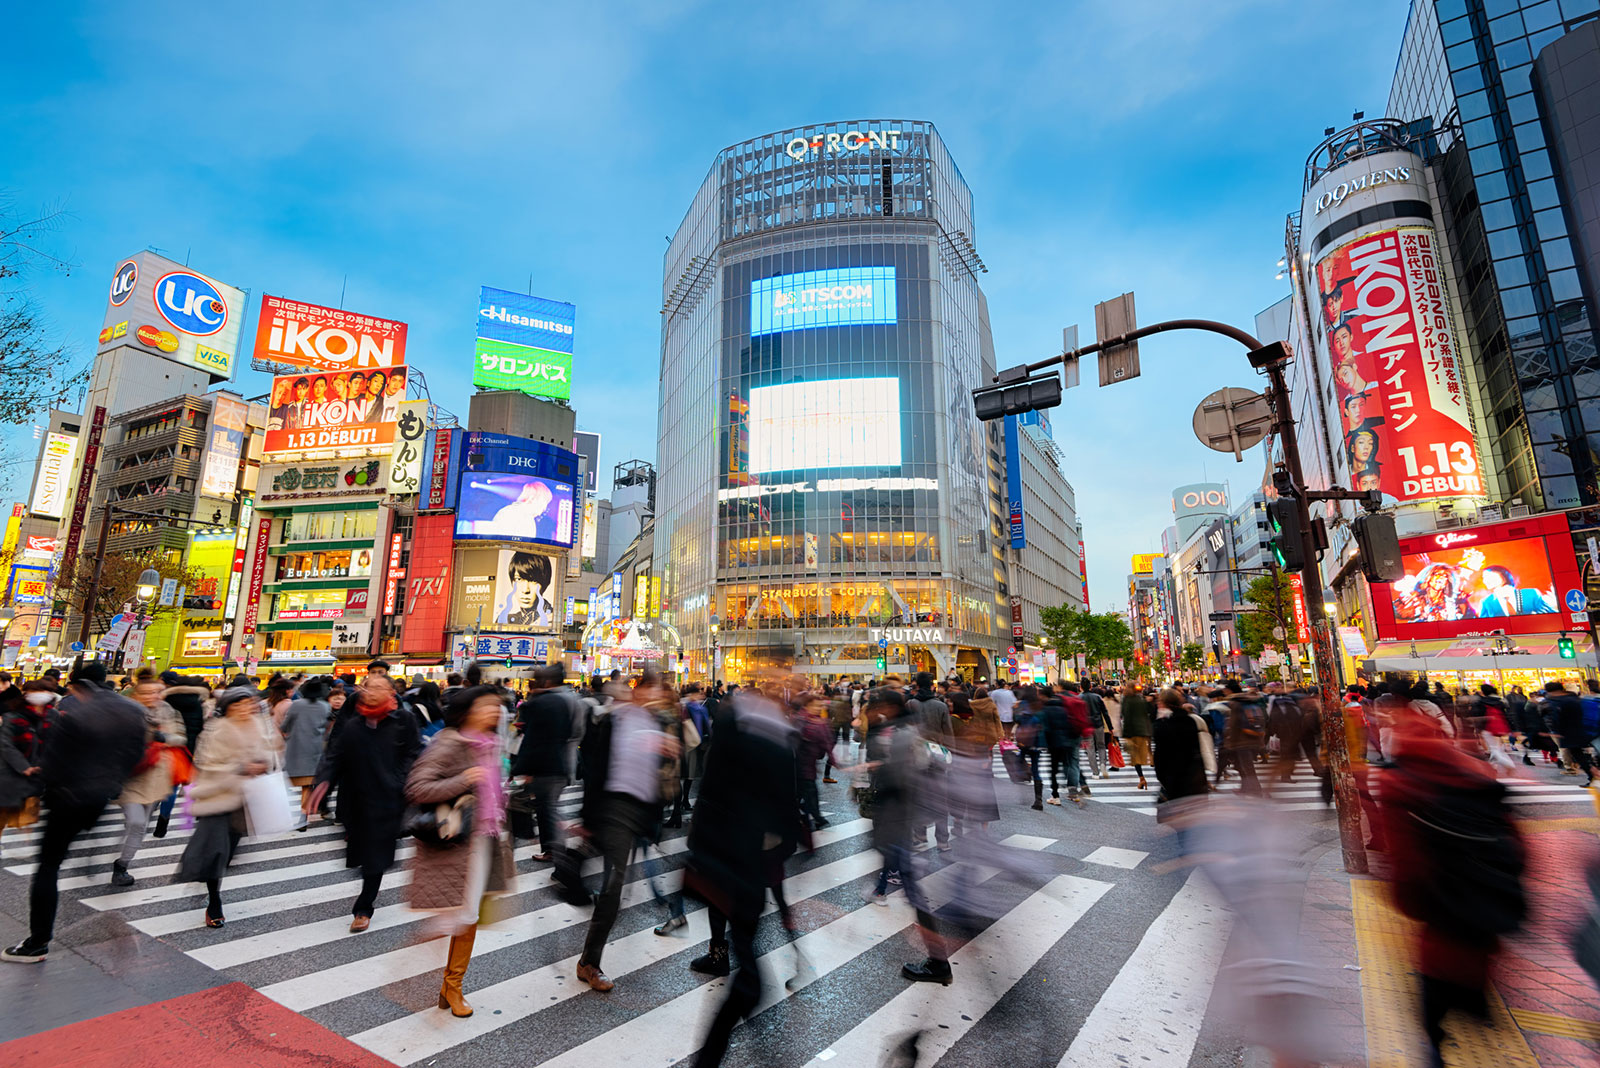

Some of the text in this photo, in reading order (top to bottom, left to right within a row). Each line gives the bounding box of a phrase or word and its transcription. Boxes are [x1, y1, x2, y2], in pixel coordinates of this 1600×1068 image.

[787, 130, 902, 163] QFRONT
[164, 280, 222, 326] UC
[801, 284, 873, 304] ITSCOM
[1348, 237, 1415, 353] iKON
[480, 305, 573, 335] Hisamitsu
[268, 317, 395, 367] iKON
[199, 350, 229, 368] VISA
[312, 358, 350, 371] アイコン
[480, 353, 567, 383] サロンパス
[1379, 349, 1419, 433] アイコン
[302, 399, 368, 426] iKON
[287, 428, 377, 449] 1.13 DEBUT!
[391, 409, 425, 490] もんじゃ
[508, 455, 537, 469] DHC
[1397, 441, 1477, 478] 1.13
[1403, 475, 1482, 497] DEBUT!
[1009, 500, 1023, 540] SEIBU
[286, 566, 346, 580] Euphoria
[347, 591, 368, 606] JTB
[464, 593, 491, 602] mobile
[465, 584, 491, 594] DMM
[761, 586, 885, 600] STARBUCKS COFFEE
[871, 629, 943, 642] TSUTAYA
